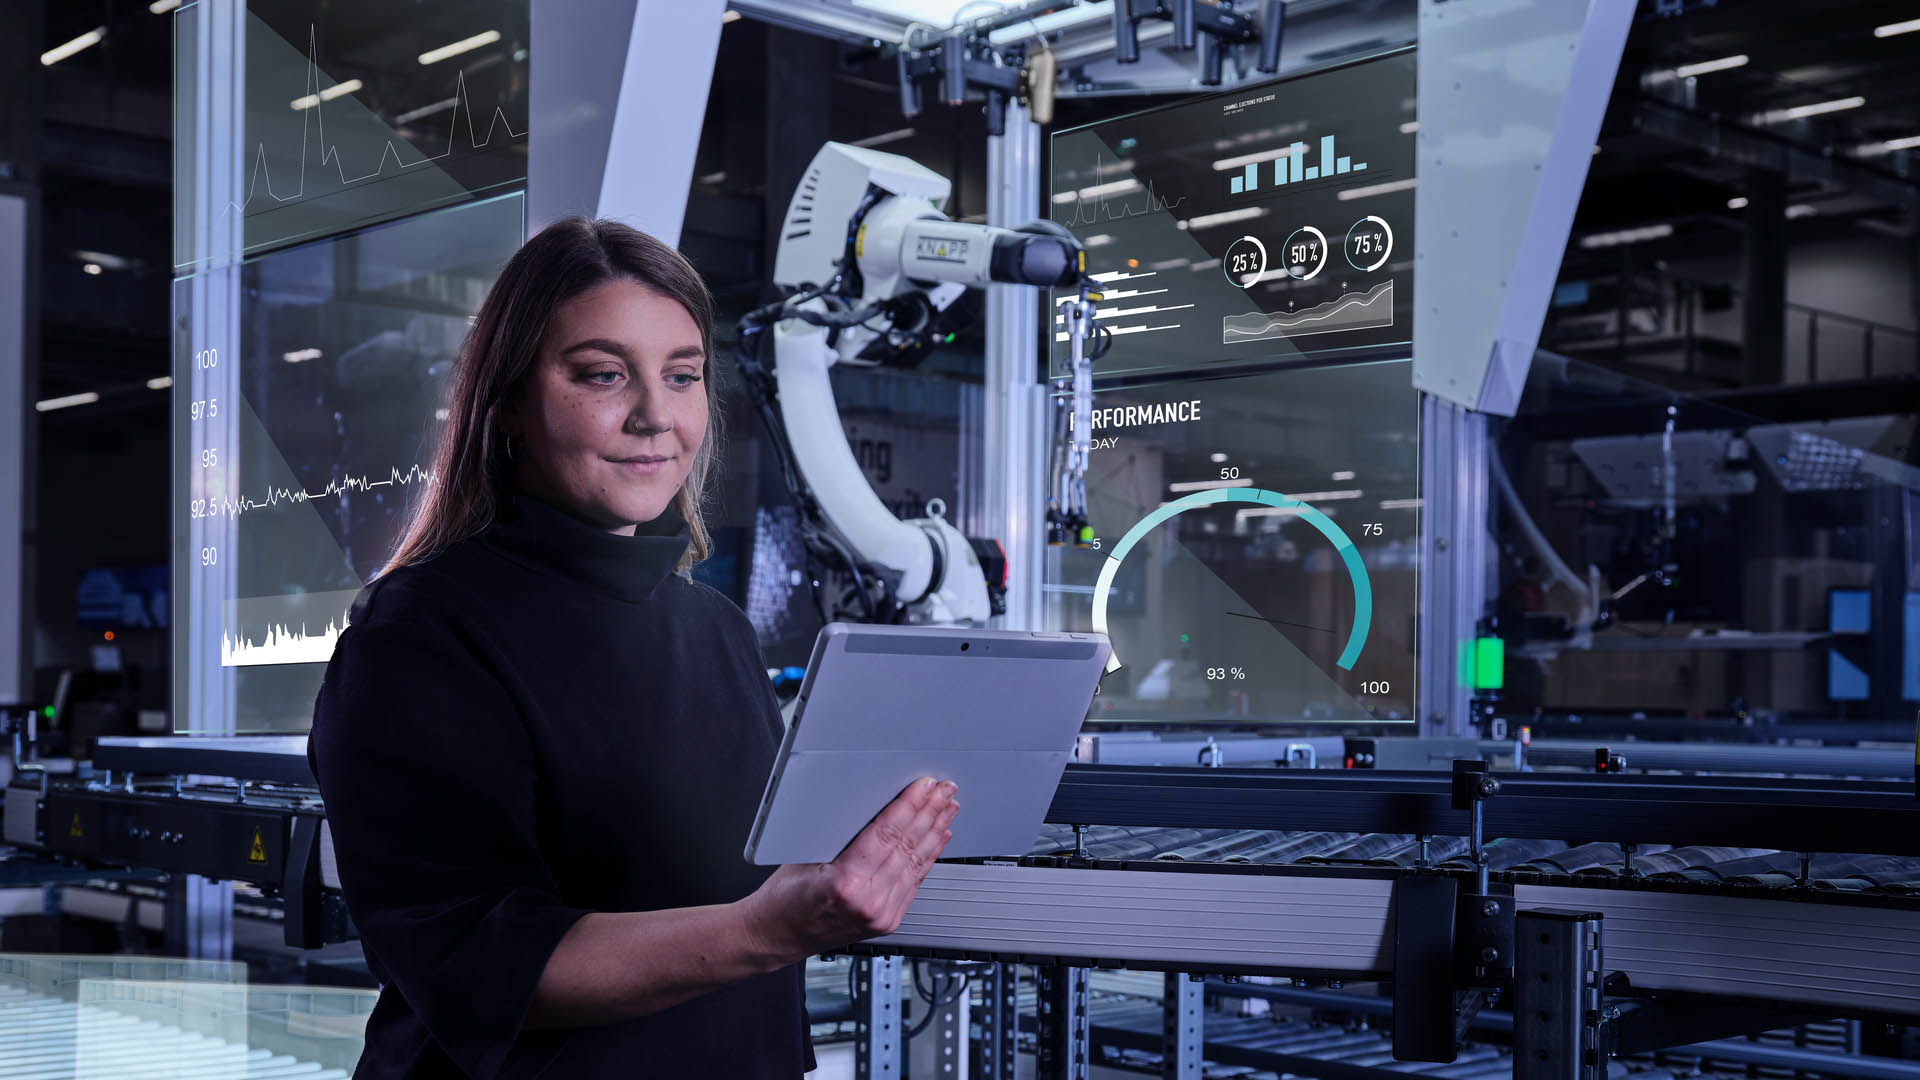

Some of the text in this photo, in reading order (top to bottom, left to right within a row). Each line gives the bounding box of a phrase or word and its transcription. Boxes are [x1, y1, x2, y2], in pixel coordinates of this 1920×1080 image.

[917, 239, 968, 259] KNAPP
[1291, 243, 1318, 264] 50 %
[1354, 233, 1383, 255] 75 %
[1232, 252, 1258, 272] 25 %
[195, 348, 217, 370] 100
[191, 398, 217, 421] 97.5
[1069, 399, 1201, 431] RFORMANCE
[1068, 436, 1119, 450] TDAY
[202, 448, 217, 468] 95
[1220, 467, 1240, 480] 50
[190, 497, 217, 519] 92.5
[1362, 523, 1384, 536] 75
[202, 546, 217, 566] 90
[1206, 667, 1246, 680] 93 %
[1360, 681, 1390, 694] 100
